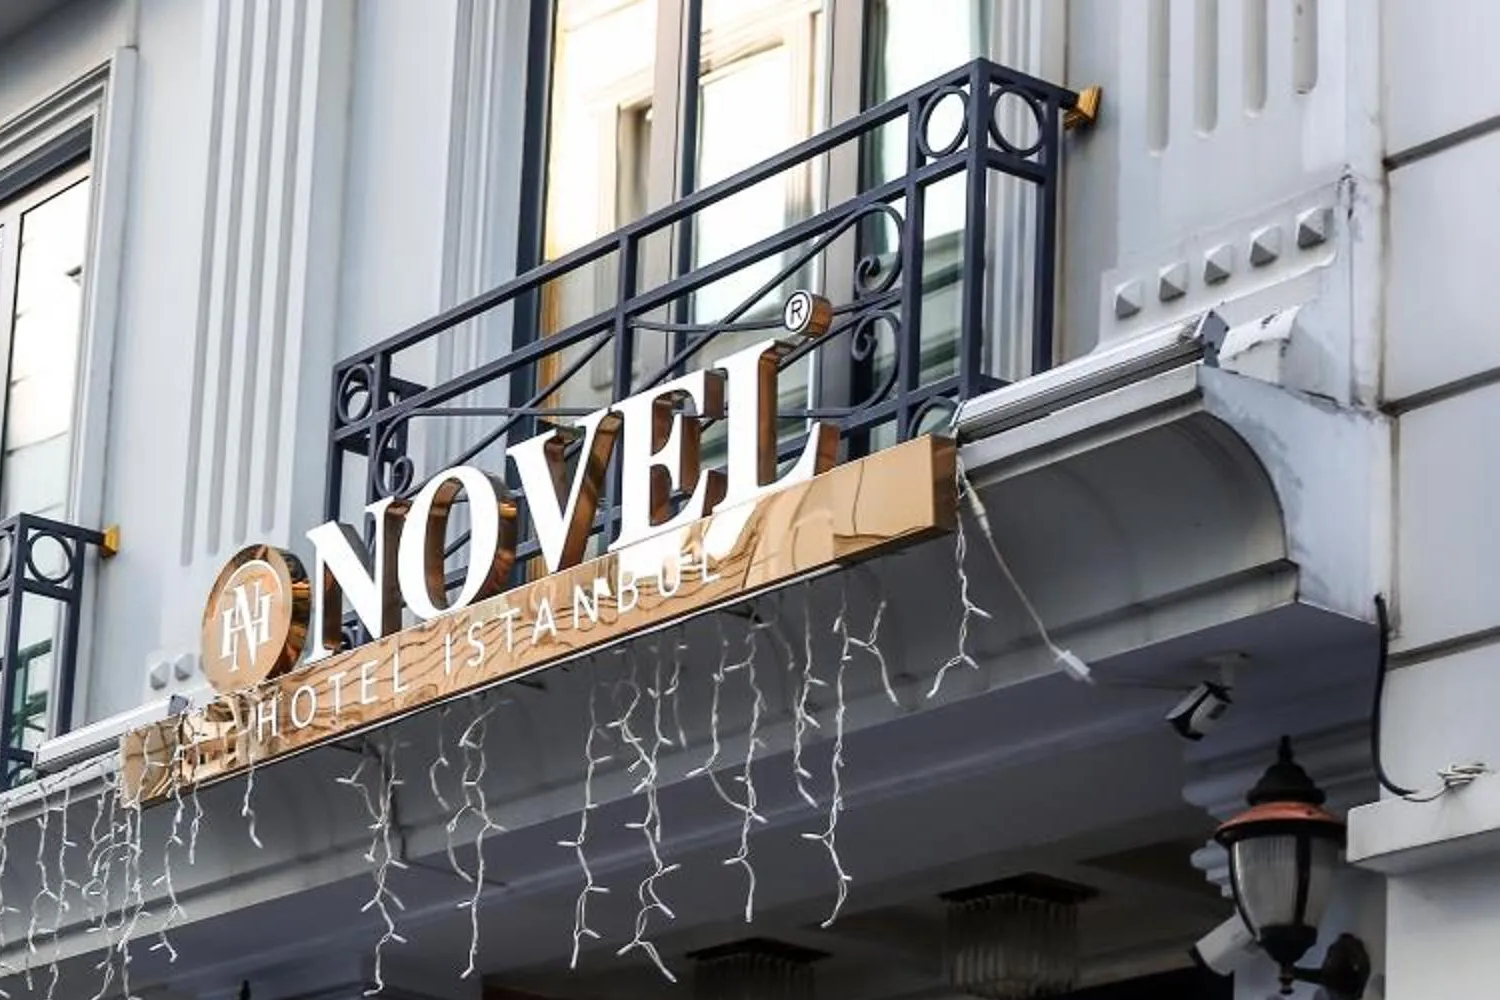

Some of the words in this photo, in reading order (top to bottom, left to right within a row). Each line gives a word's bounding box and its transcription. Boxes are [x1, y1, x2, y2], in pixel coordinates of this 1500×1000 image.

[303, 340, 826, 664] NOVEL
[255, 640, 411, 742] HOTEL
[443, 550, 722, 676] ISTANBUL
